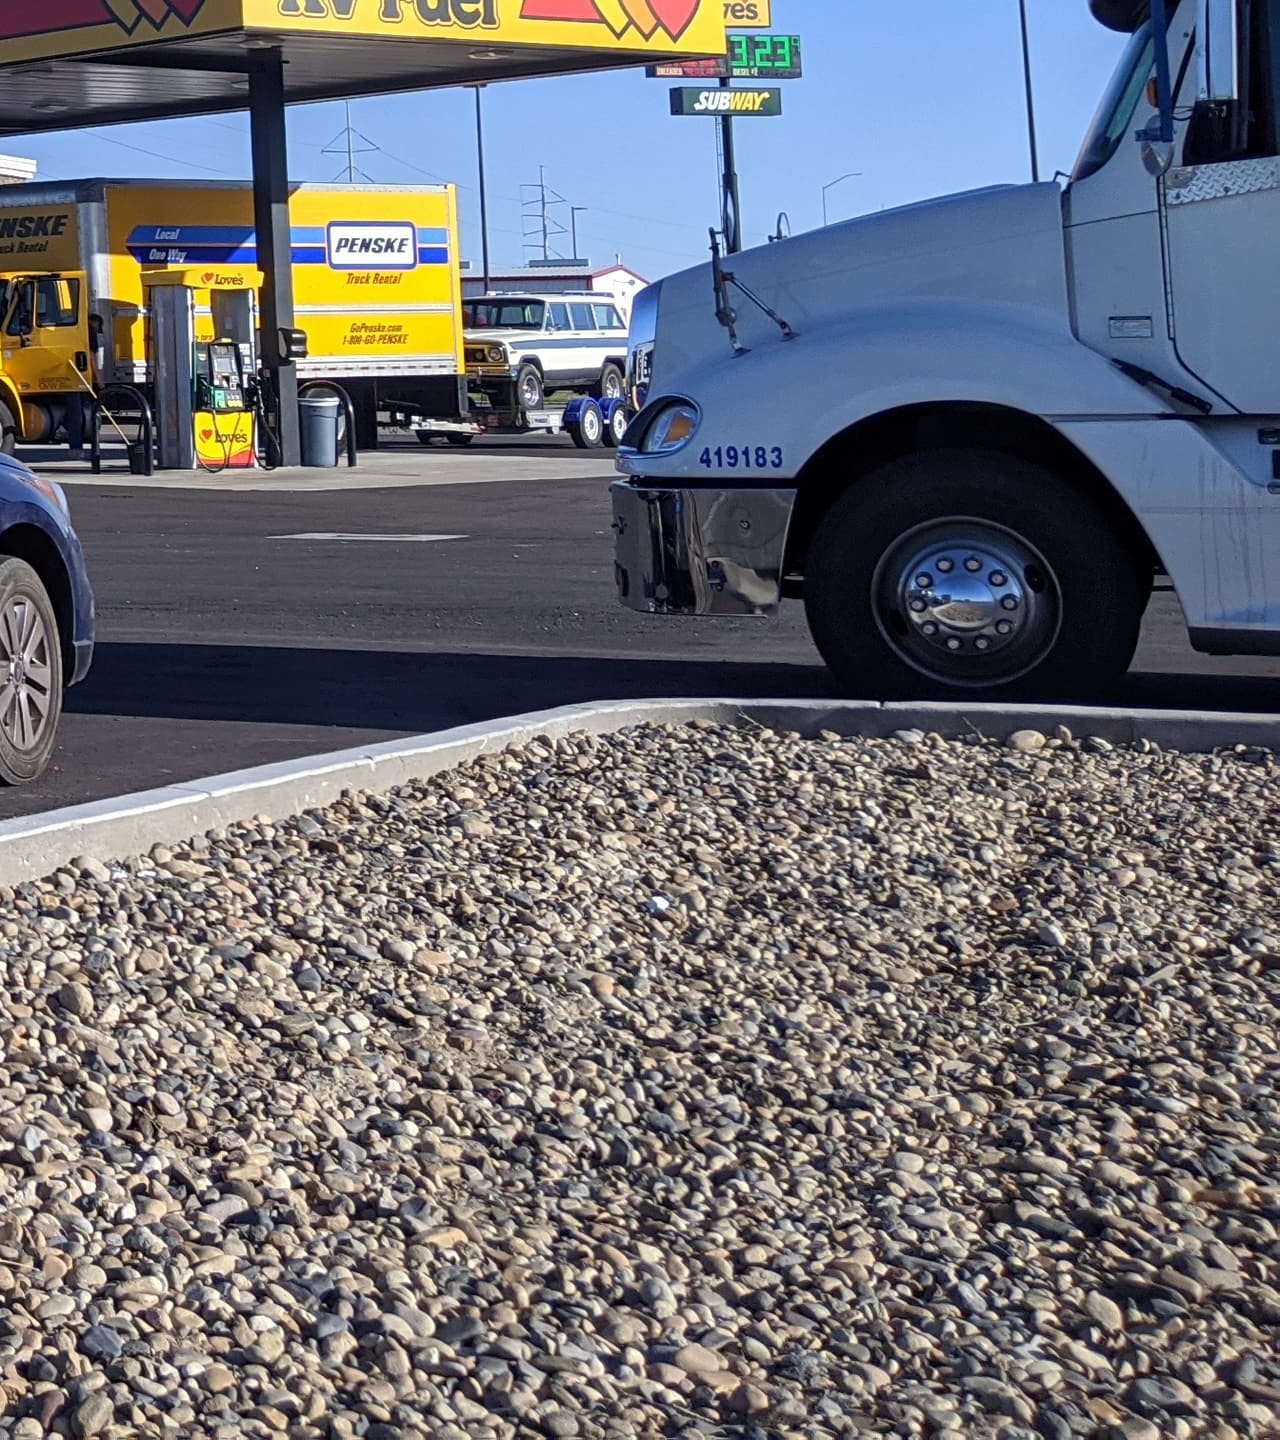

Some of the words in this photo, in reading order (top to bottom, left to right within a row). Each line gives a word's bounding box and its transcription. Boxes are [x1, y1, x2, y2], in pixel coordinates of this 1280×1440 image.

[694, 91, 770, 111] SUBWAY
[155, 228, 180, 240] Local
[16, 240, 48, 253] Rental
[335, 237, 408, 254] PENSKE
[149, 248, 166, 260] One
[167, 248, 187, 263] Way
[346, 273, 370, 285] Truck
[372, 273, 402, 285] Rental
[343, 334, 408, 345] 1-800-GO-PENSKE
[699, 446, 783, 468] 419183
